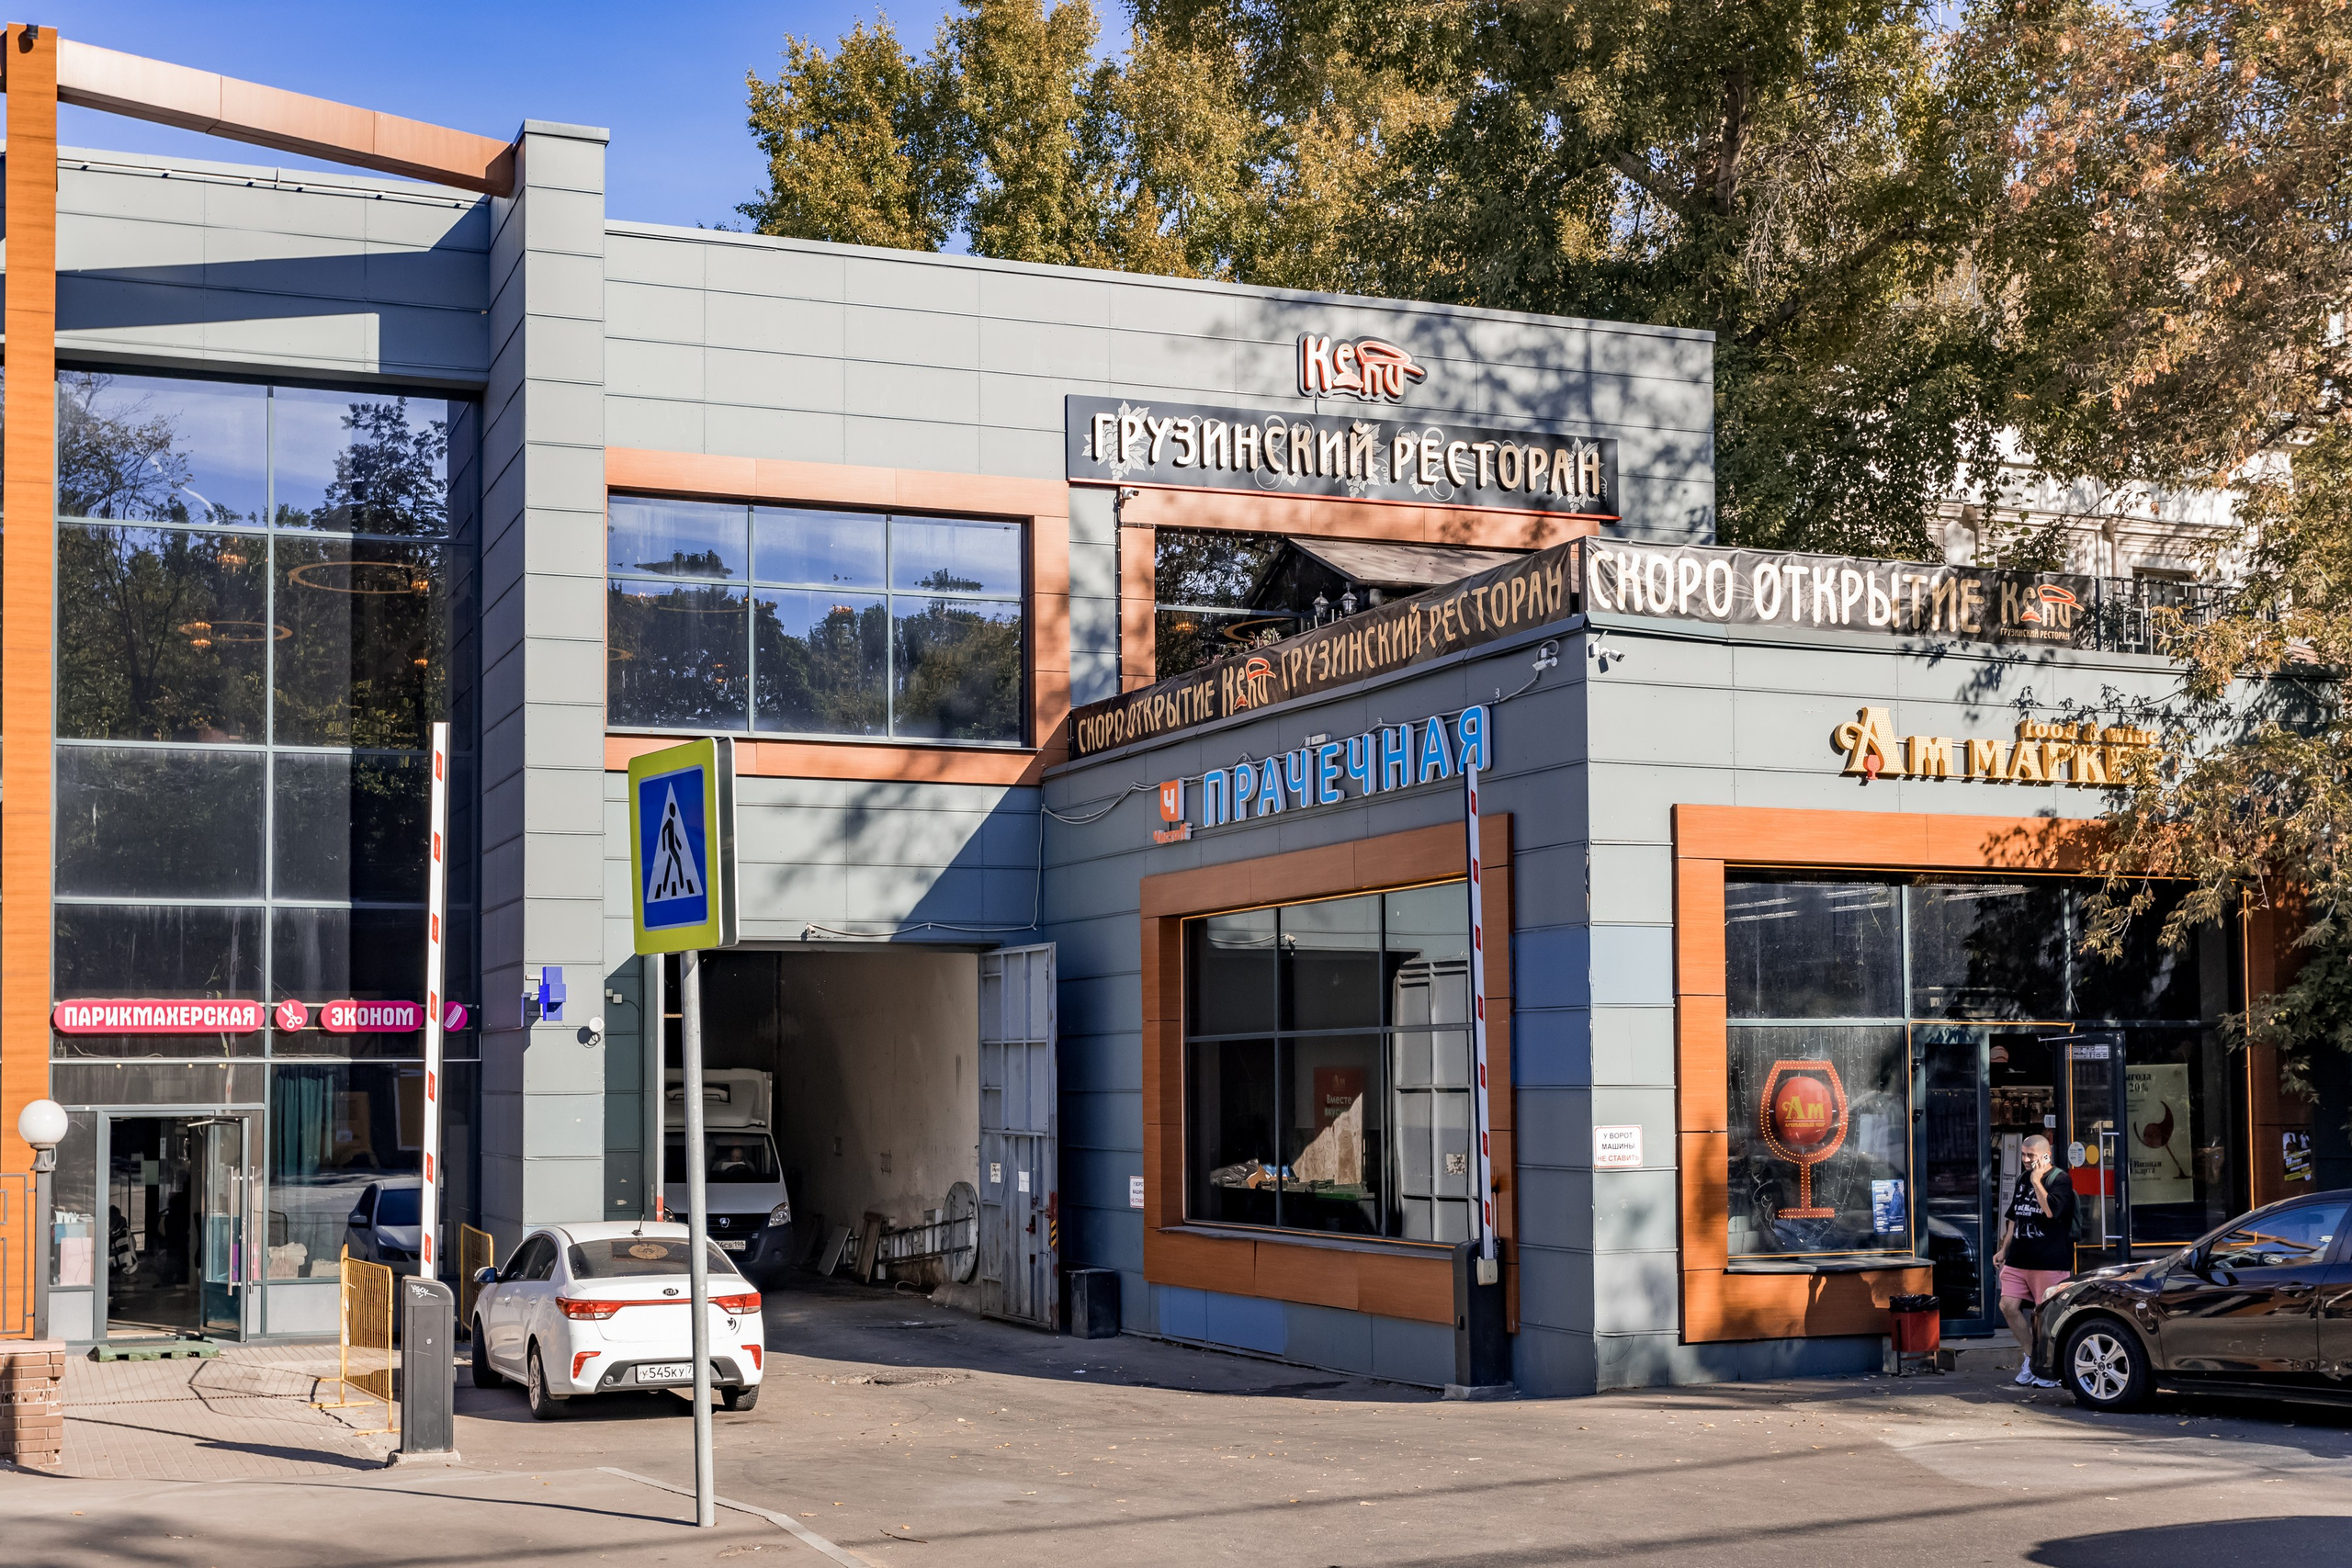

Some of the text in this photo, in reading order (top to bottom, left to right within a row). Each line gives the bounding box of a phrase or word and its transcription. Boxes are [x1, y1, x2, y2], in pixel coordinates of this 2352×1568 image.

[1092, 412, 1600, 495] ГРУЗИНСКИЙ РЕСТОРАН
[1588, 549, 1734, 617] СКОРО
[1754, 563, 1983, 633] ОТКРЫТИЕ
[2000, 628, 2070, 640] ГРУЗИНСКИЙ РЕСТОРАН
[1078, 708, 1124, 753] СКОРО
[1126, 680, 1215, 738] ОТКРЫТИЕ
[1281, 603, 1421, 691] ГРУЗИНСКИЙ
[1429, 563, 1562, 649] РЕСТОРАН
[2022, 718, 2078, 740] food
[2106, 724, 2161, 744] wine
[1204, 705, 1491, 828] ПРАЧЕЧНАЯ
[64, 1006, 255, 1026] ПАРИКМАХЕРСКАЯ
[331, 1007, 414, 1026] ЭКОНОМ
[1326, 1094, 1352, 1104] Вместе
[664, 1288, 678, 1296] KIA
